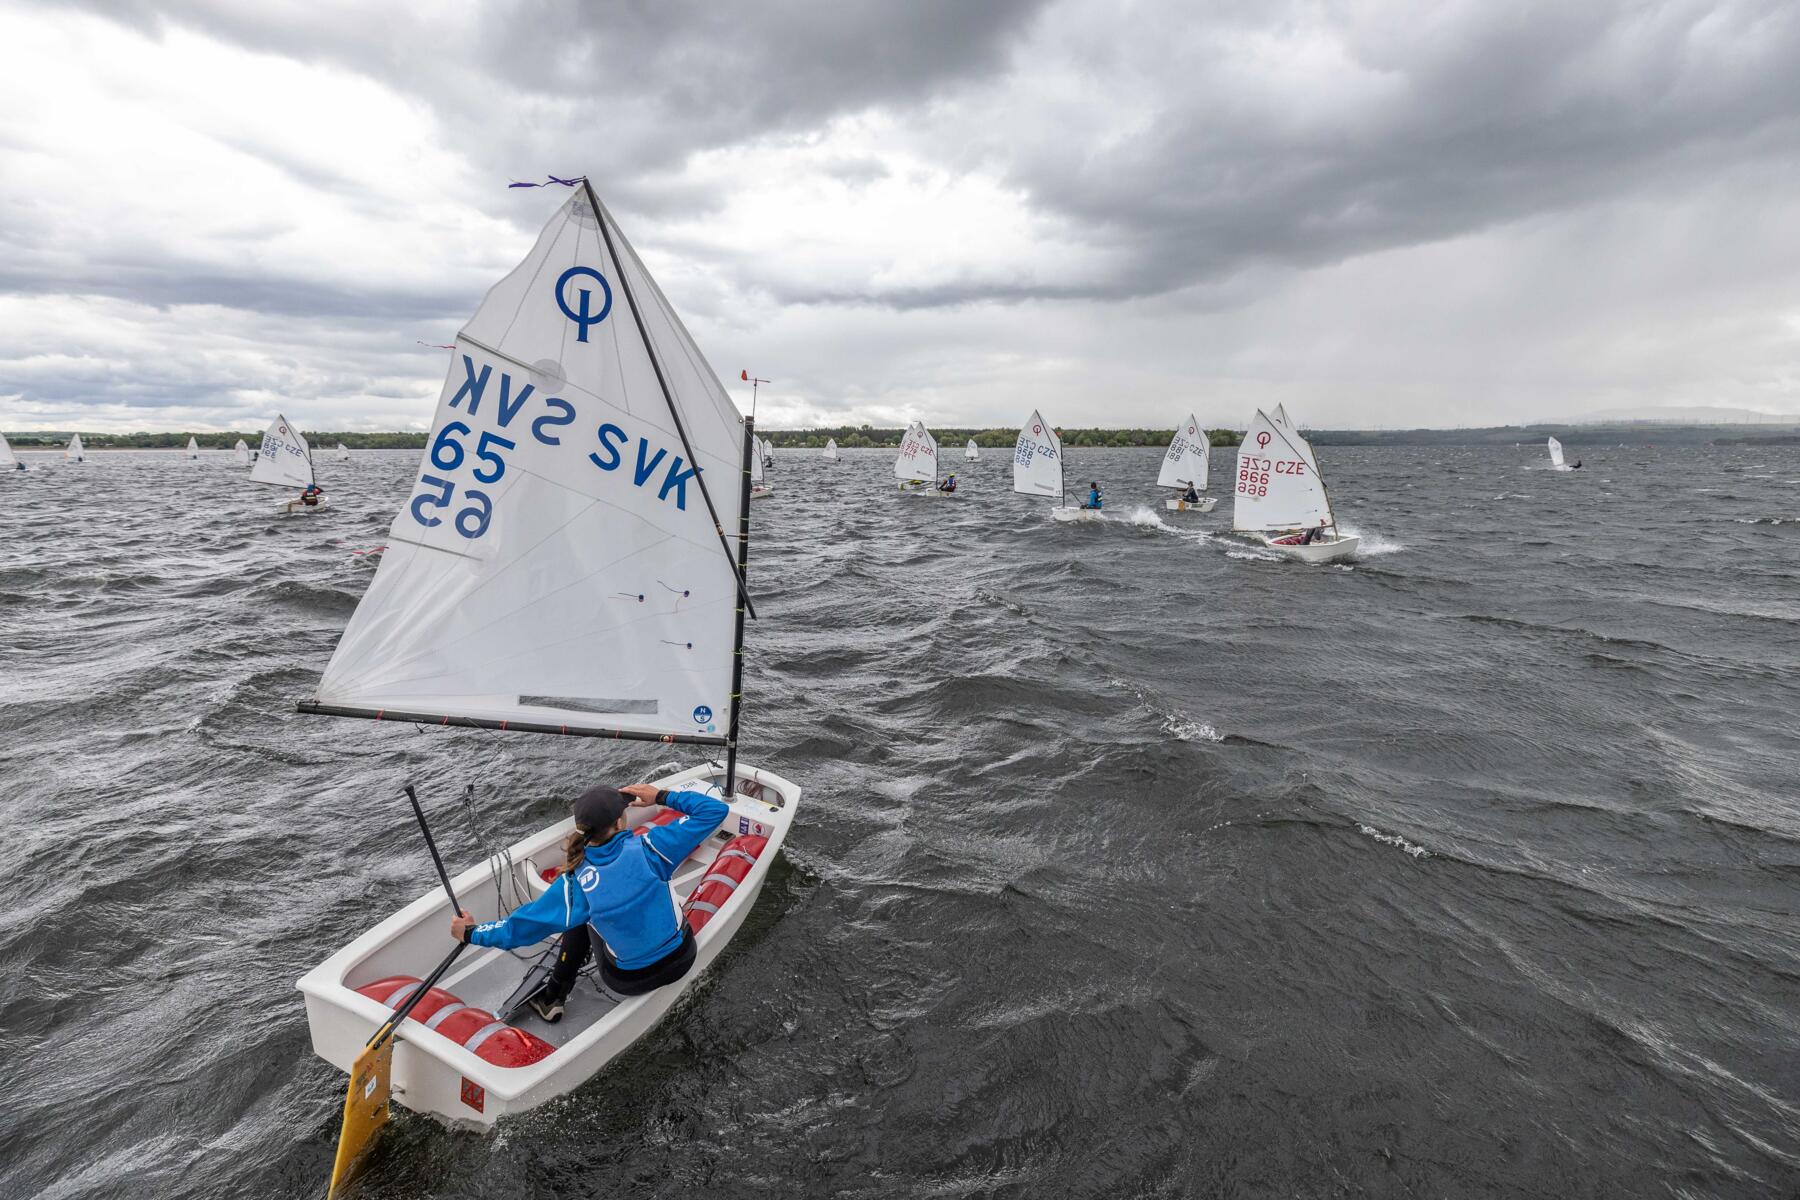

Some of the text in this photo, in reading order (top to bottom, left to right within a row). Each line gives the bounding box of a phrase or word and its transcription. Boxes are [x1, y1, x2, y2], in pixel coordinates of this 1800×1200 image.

[285, 444, 302, 457] CZE
[430, 421, 516, 484] 65
[921, 446, 933, 456] CZE
[1037, 445, 1056, 459] CZE
[1170, 444, 1184, 455] 881
[1189, 444, 1203, 457] CZE
[588, 423, 704, 511] SVK
[1275, 461, 1306, 475] CZE
[1239, 470, 1270, 485] 866
